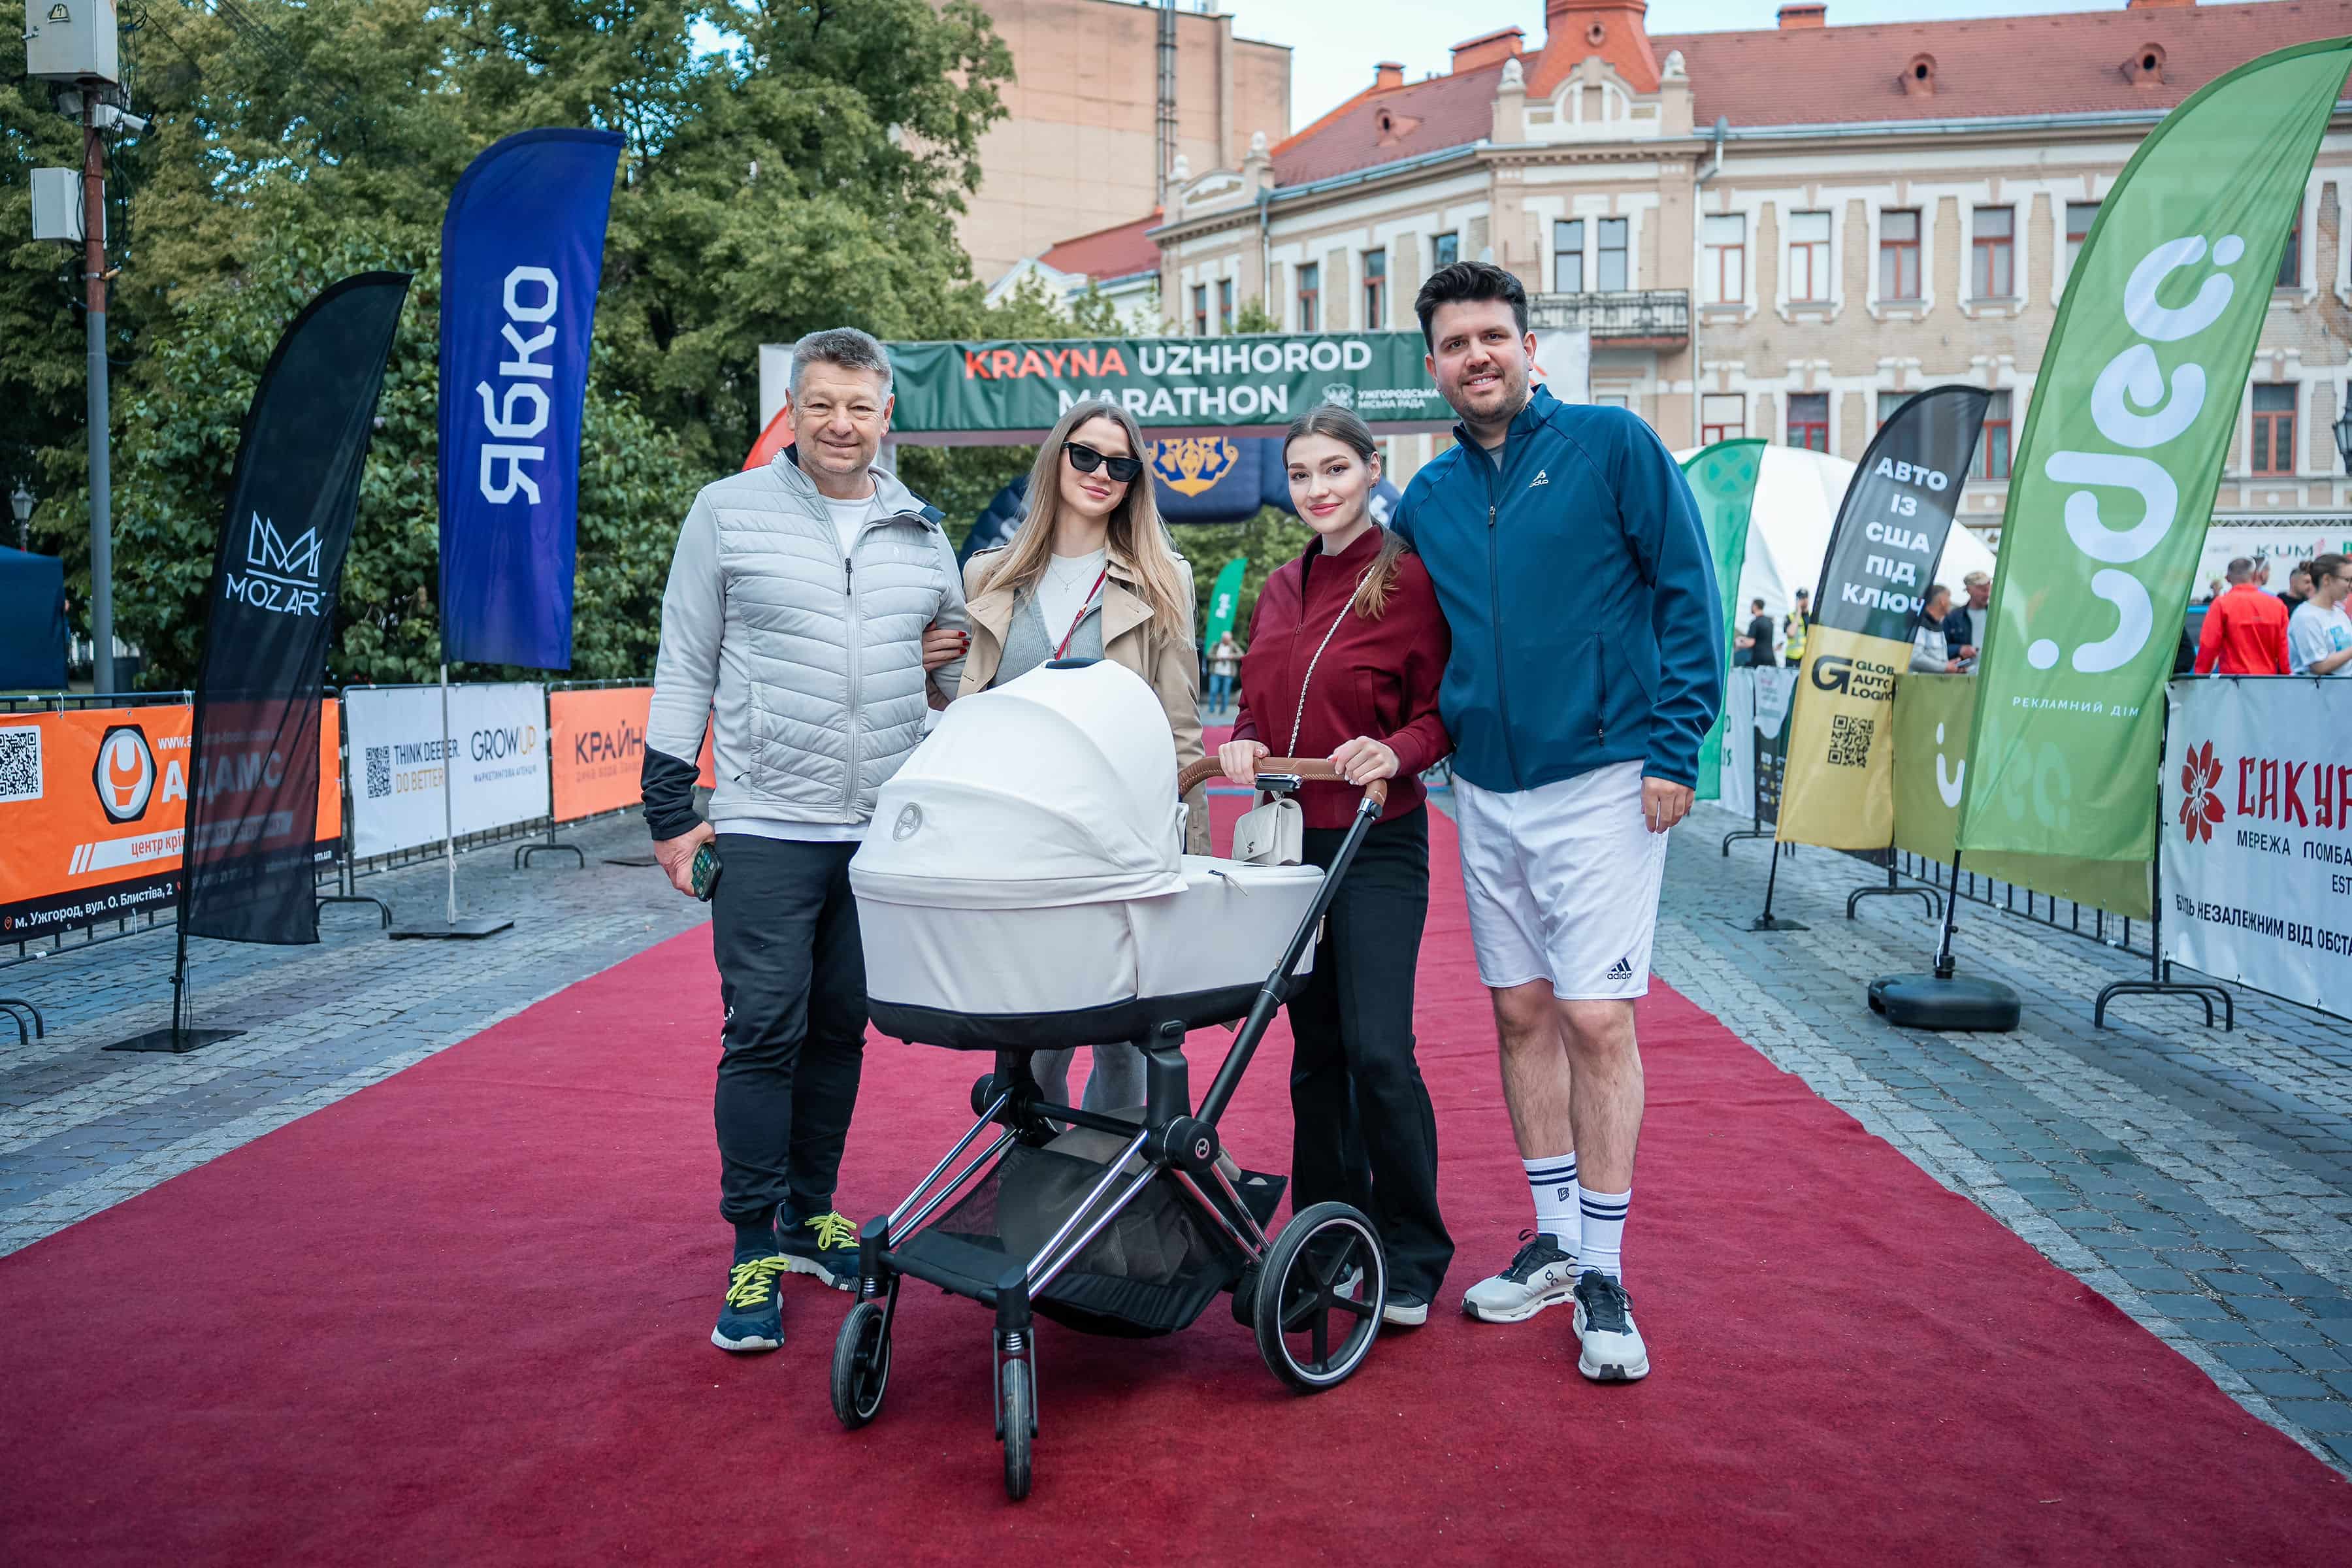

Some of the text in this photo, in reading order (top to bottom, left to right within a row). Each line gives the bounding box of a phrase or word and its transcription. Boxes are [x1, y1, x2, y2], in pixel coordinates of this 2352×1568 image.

[964, 340, 1371, 380] KRAYNA UZHHOROD
[1358, 389, 1440, 399] УЖГОРОДСЬКА
[1358, 398, 1426, 409] МІСЬКА РАДА
[1874, 456, 1948, 491] АВТО
[1865, 521, 1930, 553] США
[1865, 553, 1916, 587] ПІД
[225, 572, 327, 616] MOZAR
[1841, 582, 1925, 617] КЛЮЧ
[2012, 695, 2139, 717] РЕКЛАМНИЙ ДІМ
[393, 742, 423, 765] THINK
[575, 719, 643, 765] КРАЙН
[396, 768, 445, 794] DO BETTER
[131, 837, 163, 858] центр
[2236, 829, 2291, 856] МЕРЕЖА
[30, 904, 83, 926] Ужгород,
[86, 900, 106, 915] вул.
[108, 895, 119, 909] О.
[120, 886, 165, 906] Блистіва,
[166, 883, 173, 896] 2
[2197, 900, 2284, 939] НЕЗАЛЕЖНИМ
[2288, 922, 2313, 948] ВІД
[1607, 971, 1632, 980] adida
